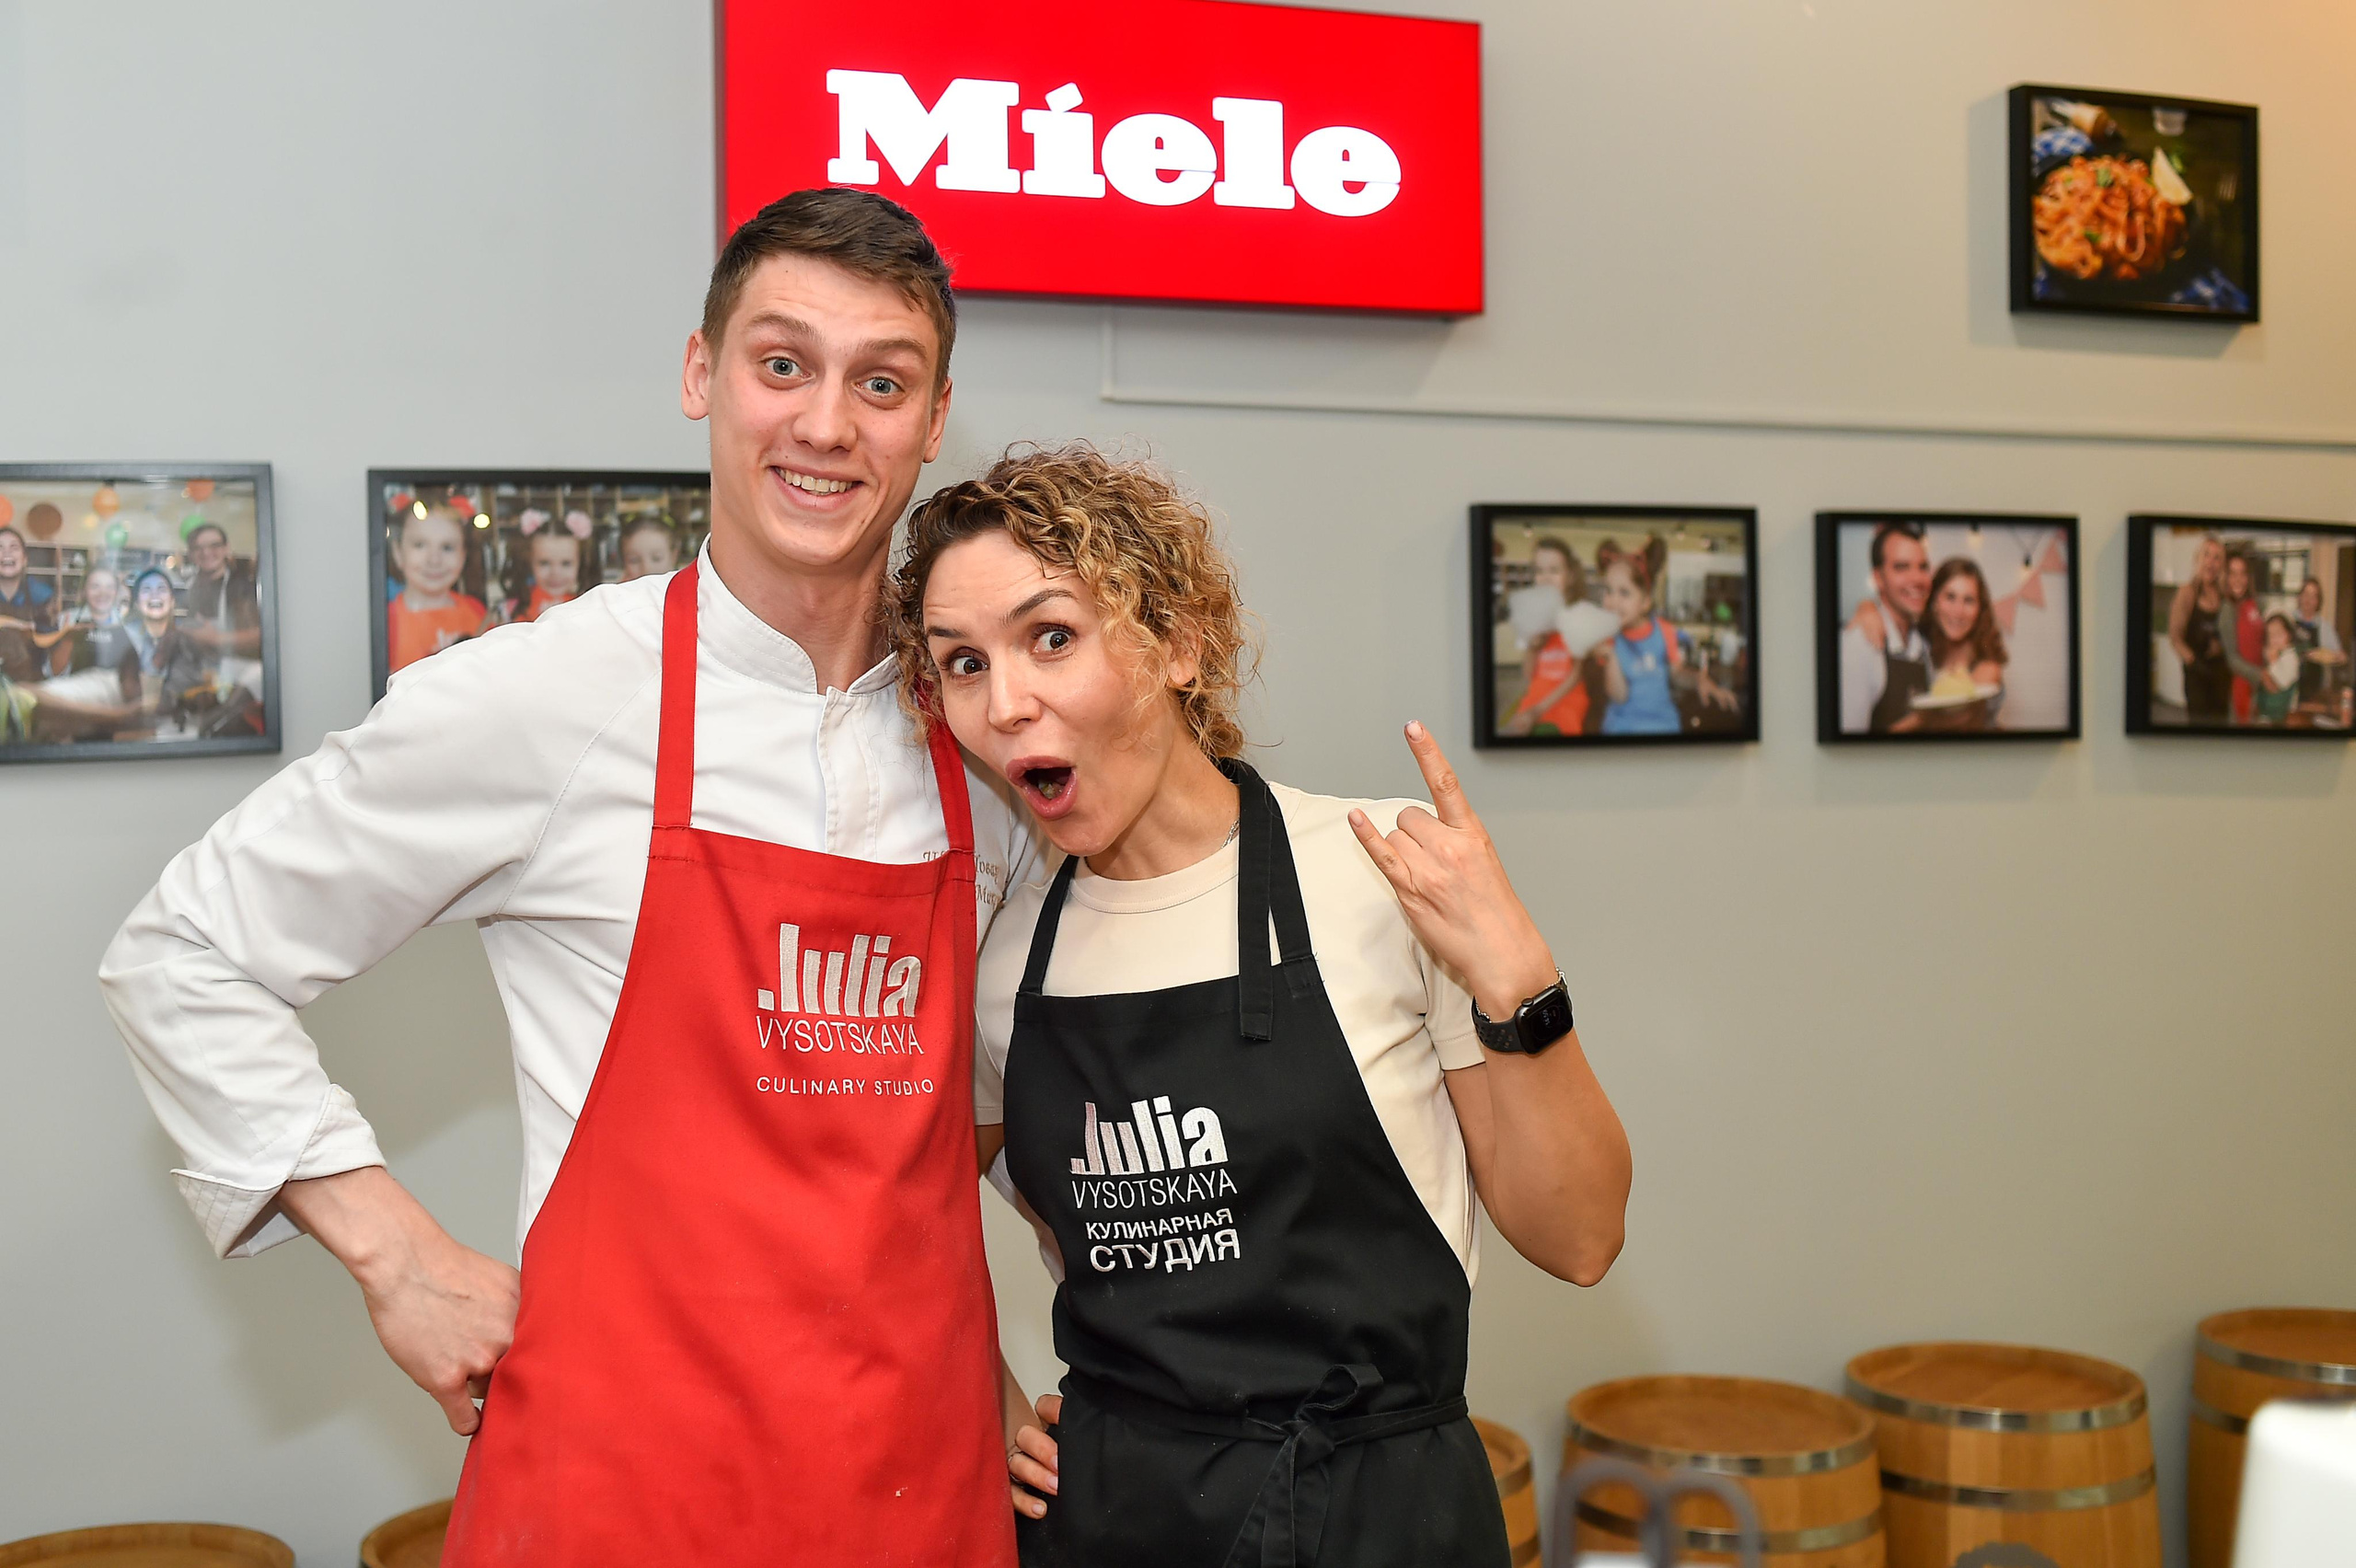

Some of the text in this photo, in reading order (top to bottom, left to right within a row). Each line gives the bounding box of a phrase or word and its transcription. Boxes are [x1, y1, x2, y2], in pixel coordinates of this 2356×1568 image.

[826, 68, 1402, 217] Miele
[757, 923, 922, 1018] Julia
[756, 1015, 925, 1055] VYSOTSKAYA
[756, 1076, 934, 1096] CULINARY STUDIO
[1069, 1095, 1229, 1176] Julia
[1071, 1168, 1238, 1209] VYSOTSKAYA
[1085, 1207, 1234, 1240] КУЛИНАРНАЯ
[1090, 1228, 1241, 1274] СТУДИЯ
